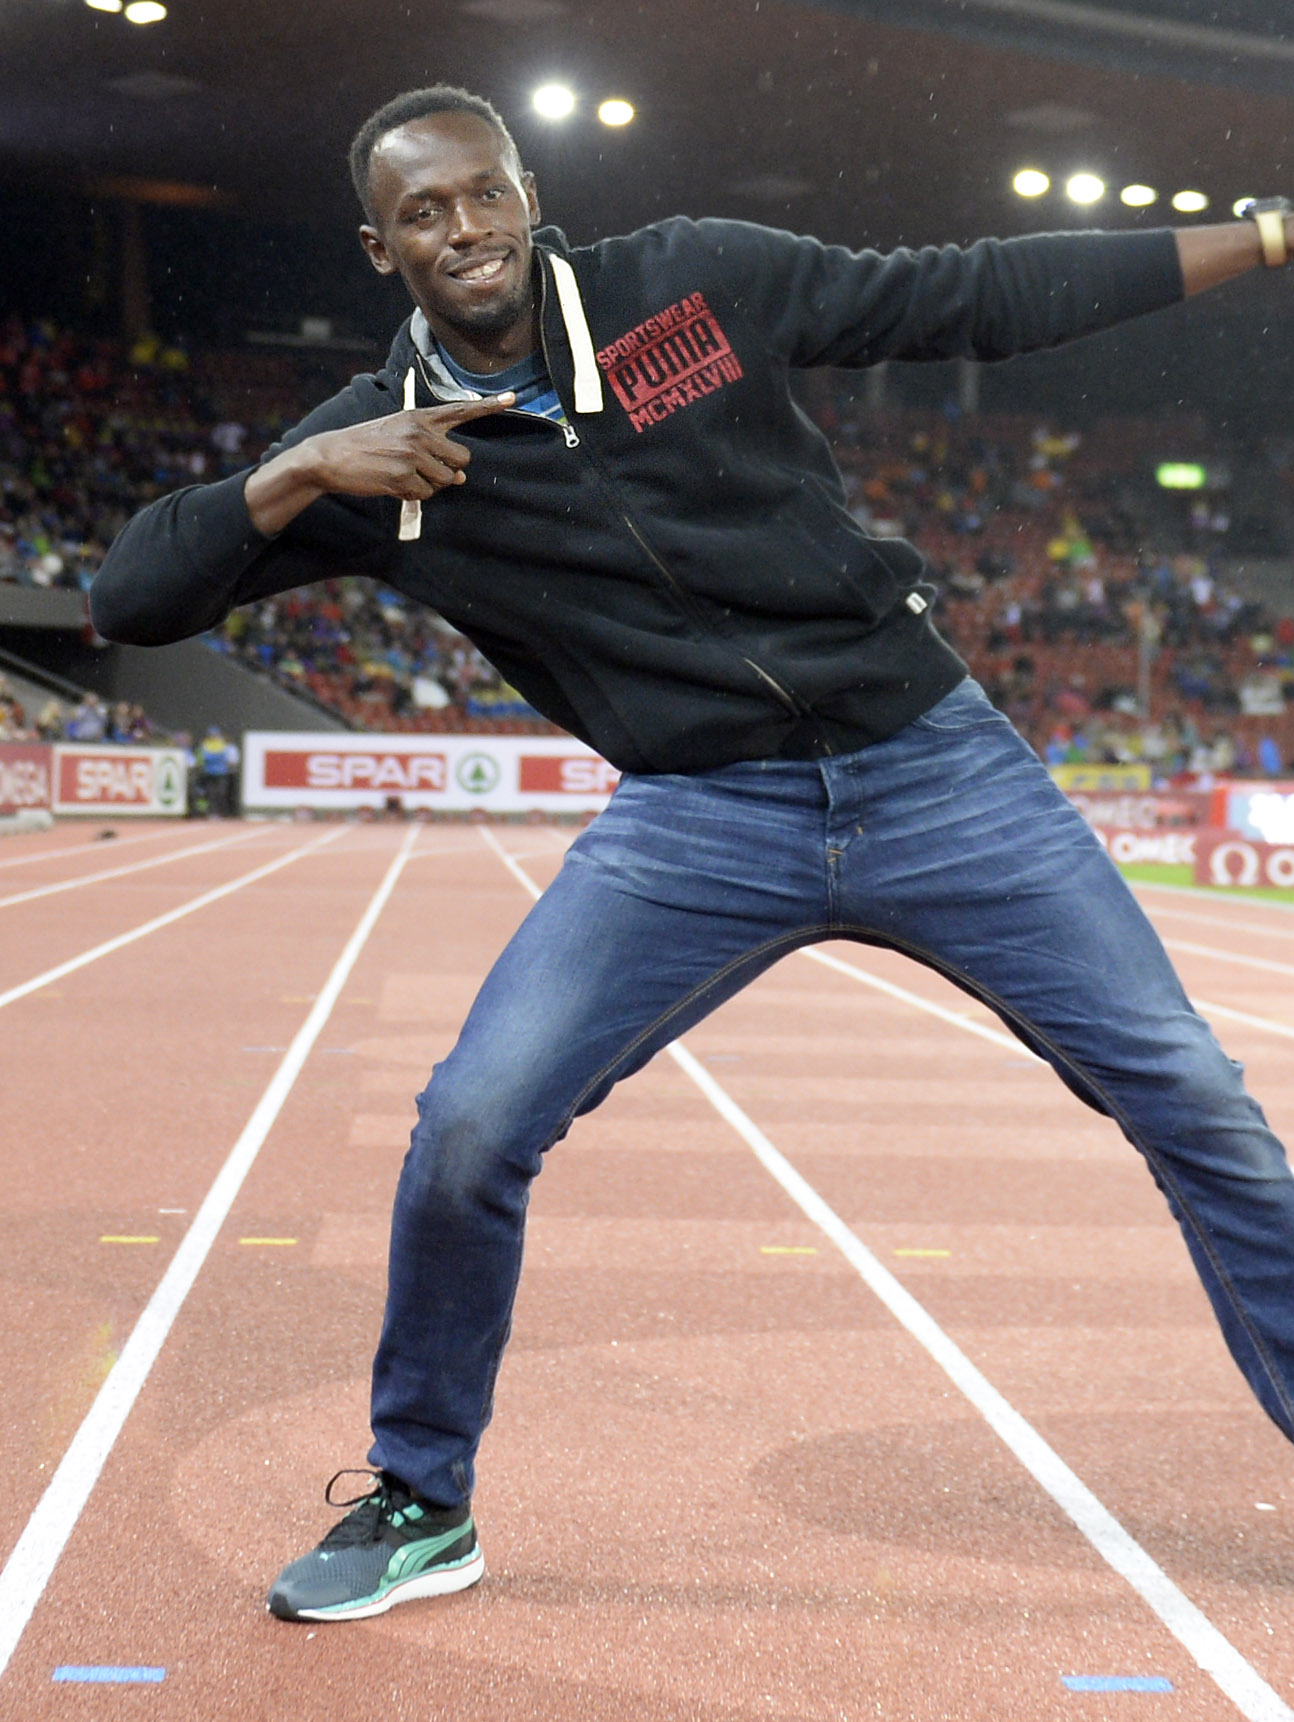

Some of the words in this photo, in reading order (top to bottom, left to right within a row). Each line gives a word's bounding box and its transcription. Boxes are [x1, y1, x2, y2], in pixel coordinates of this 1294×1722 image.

[596, 292, 708, 370] SPORTSWEAR
[614, 318, 723, 404] PUMA
[628, 353, 744, 433] MCMXLVIII
[76, 758, 151, 800] SPAR
[305, 754, 443, 789] SPAR
